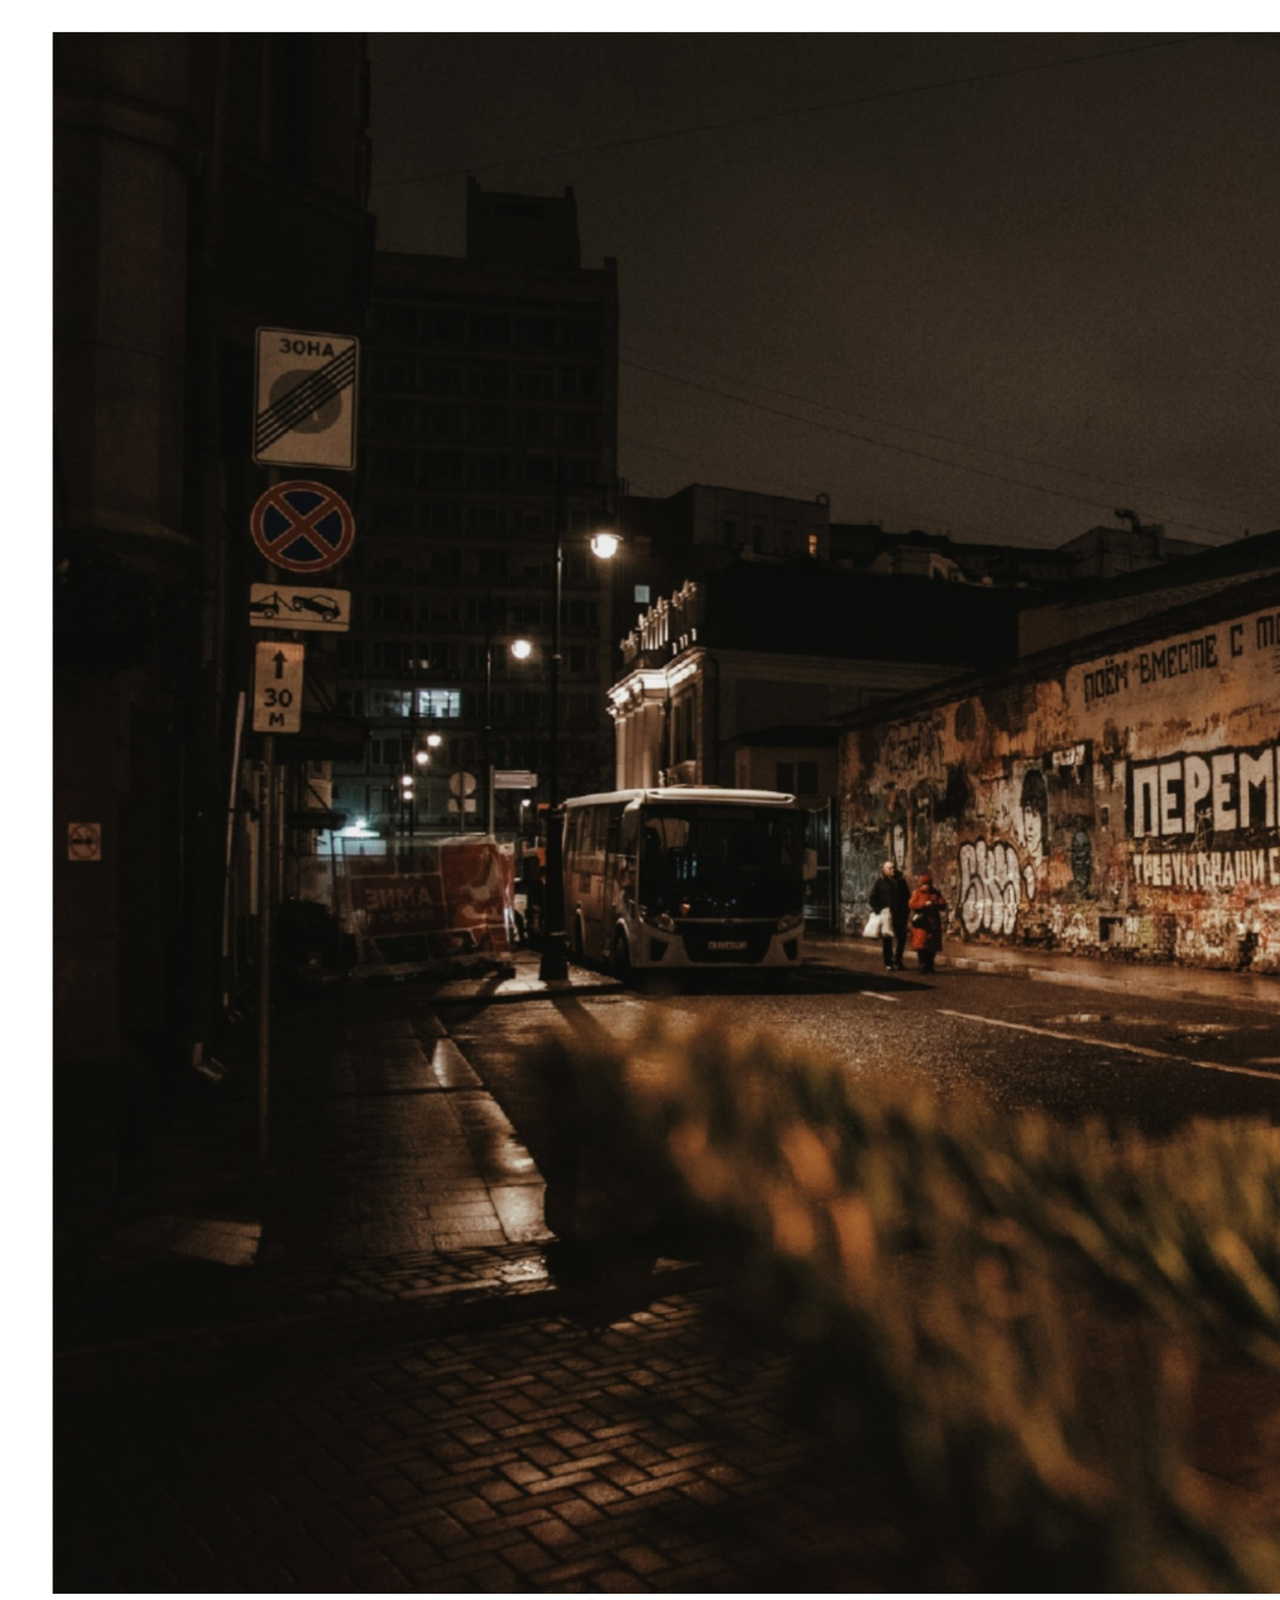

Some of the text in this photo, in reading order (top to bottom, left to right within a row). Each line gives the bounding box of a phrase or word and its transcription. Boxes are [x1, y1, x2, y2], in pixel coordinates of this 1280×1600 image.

[279, 337, 335, 359] ЗОНА
[1083, 658, 1129, 704] ПОЁМ
[1139, 634, 1219, 684] ВМЕСТЕ
[1229, 623, 1244, 658] С
[263, 688, 293, 708] 30
[268, 712, 286, 727] М
[1210, 847, 1265, 887] НАШИ
[364, 885, 434, 910] ЗИМА
